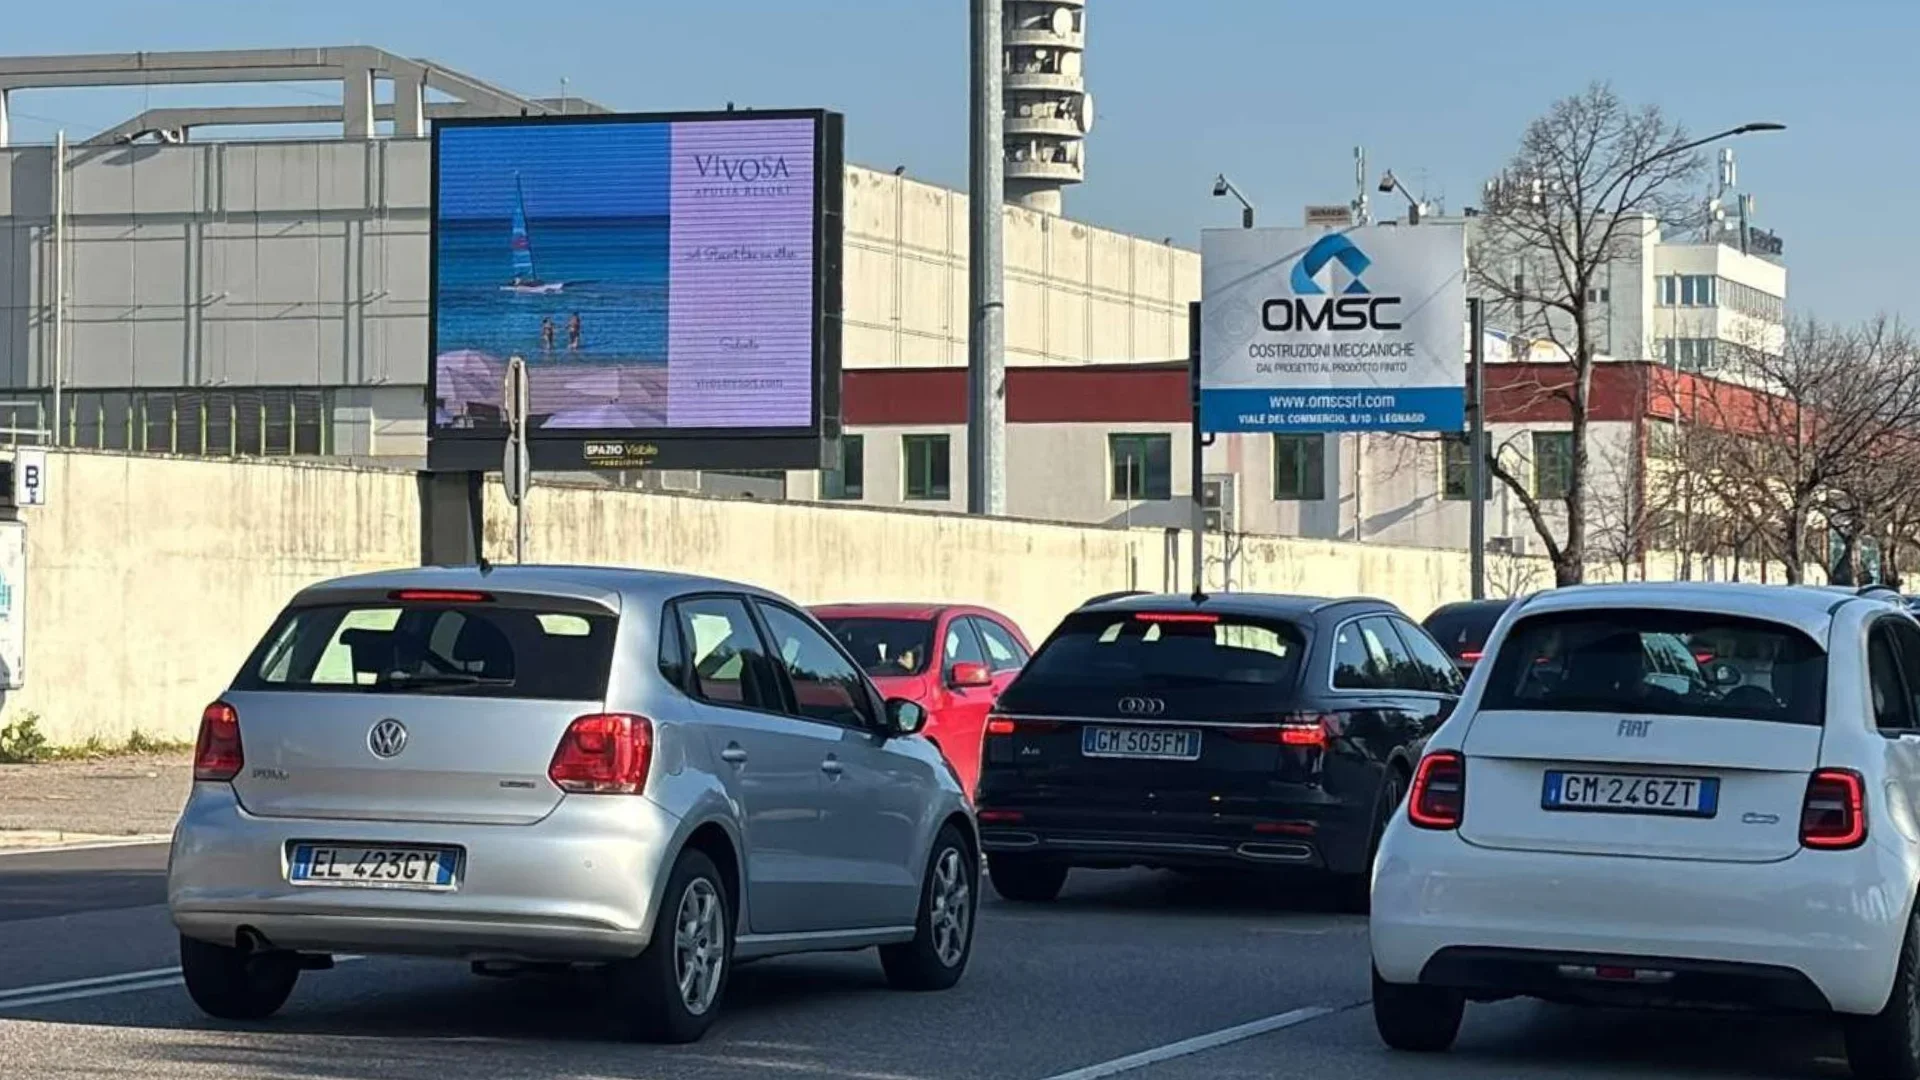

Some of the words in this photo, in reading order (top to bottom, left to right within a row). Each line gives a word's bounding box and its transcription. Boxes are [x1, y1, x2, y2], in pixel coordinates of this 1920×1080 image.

[693, 153, 790, 182] VIVOSA
[1262, 297, 1402, 331] OMSC
[1249, 343, 1330, 358] COSTRUZIONI
[1333, 342, 1415, 357] MECCANICHE
[1274, 362, 1319, 373] PROGETTO
[1332, 362, 1379, 373] PRODOTTO
[1380, 362, 1407, 372] FINITO
[1269, 393, 1396, 409] www.omscsrl.com
[1238, 414, 1266, 424] VIALE
[1267, 414, 1285, 424] DEL
[1287, 413, 1348, 424] COMMERCIO,
[1380, 413, 1426, 423] LEGNAGO
[586, 444, 623, 455] SPAZIO
[25, 466, 39, 488] B
[1617, 719, 1653, 738] FIAT
[1097, 730, 1120, 751] GM
[1127, 732, 1187, 755] 505FM
[1565, 775, 1599, 803] GM
[1607, 778, 1696, 807] 246ZT
[310, 850, 341, 876] EL
[354, 851, 438, 881] 423GY
